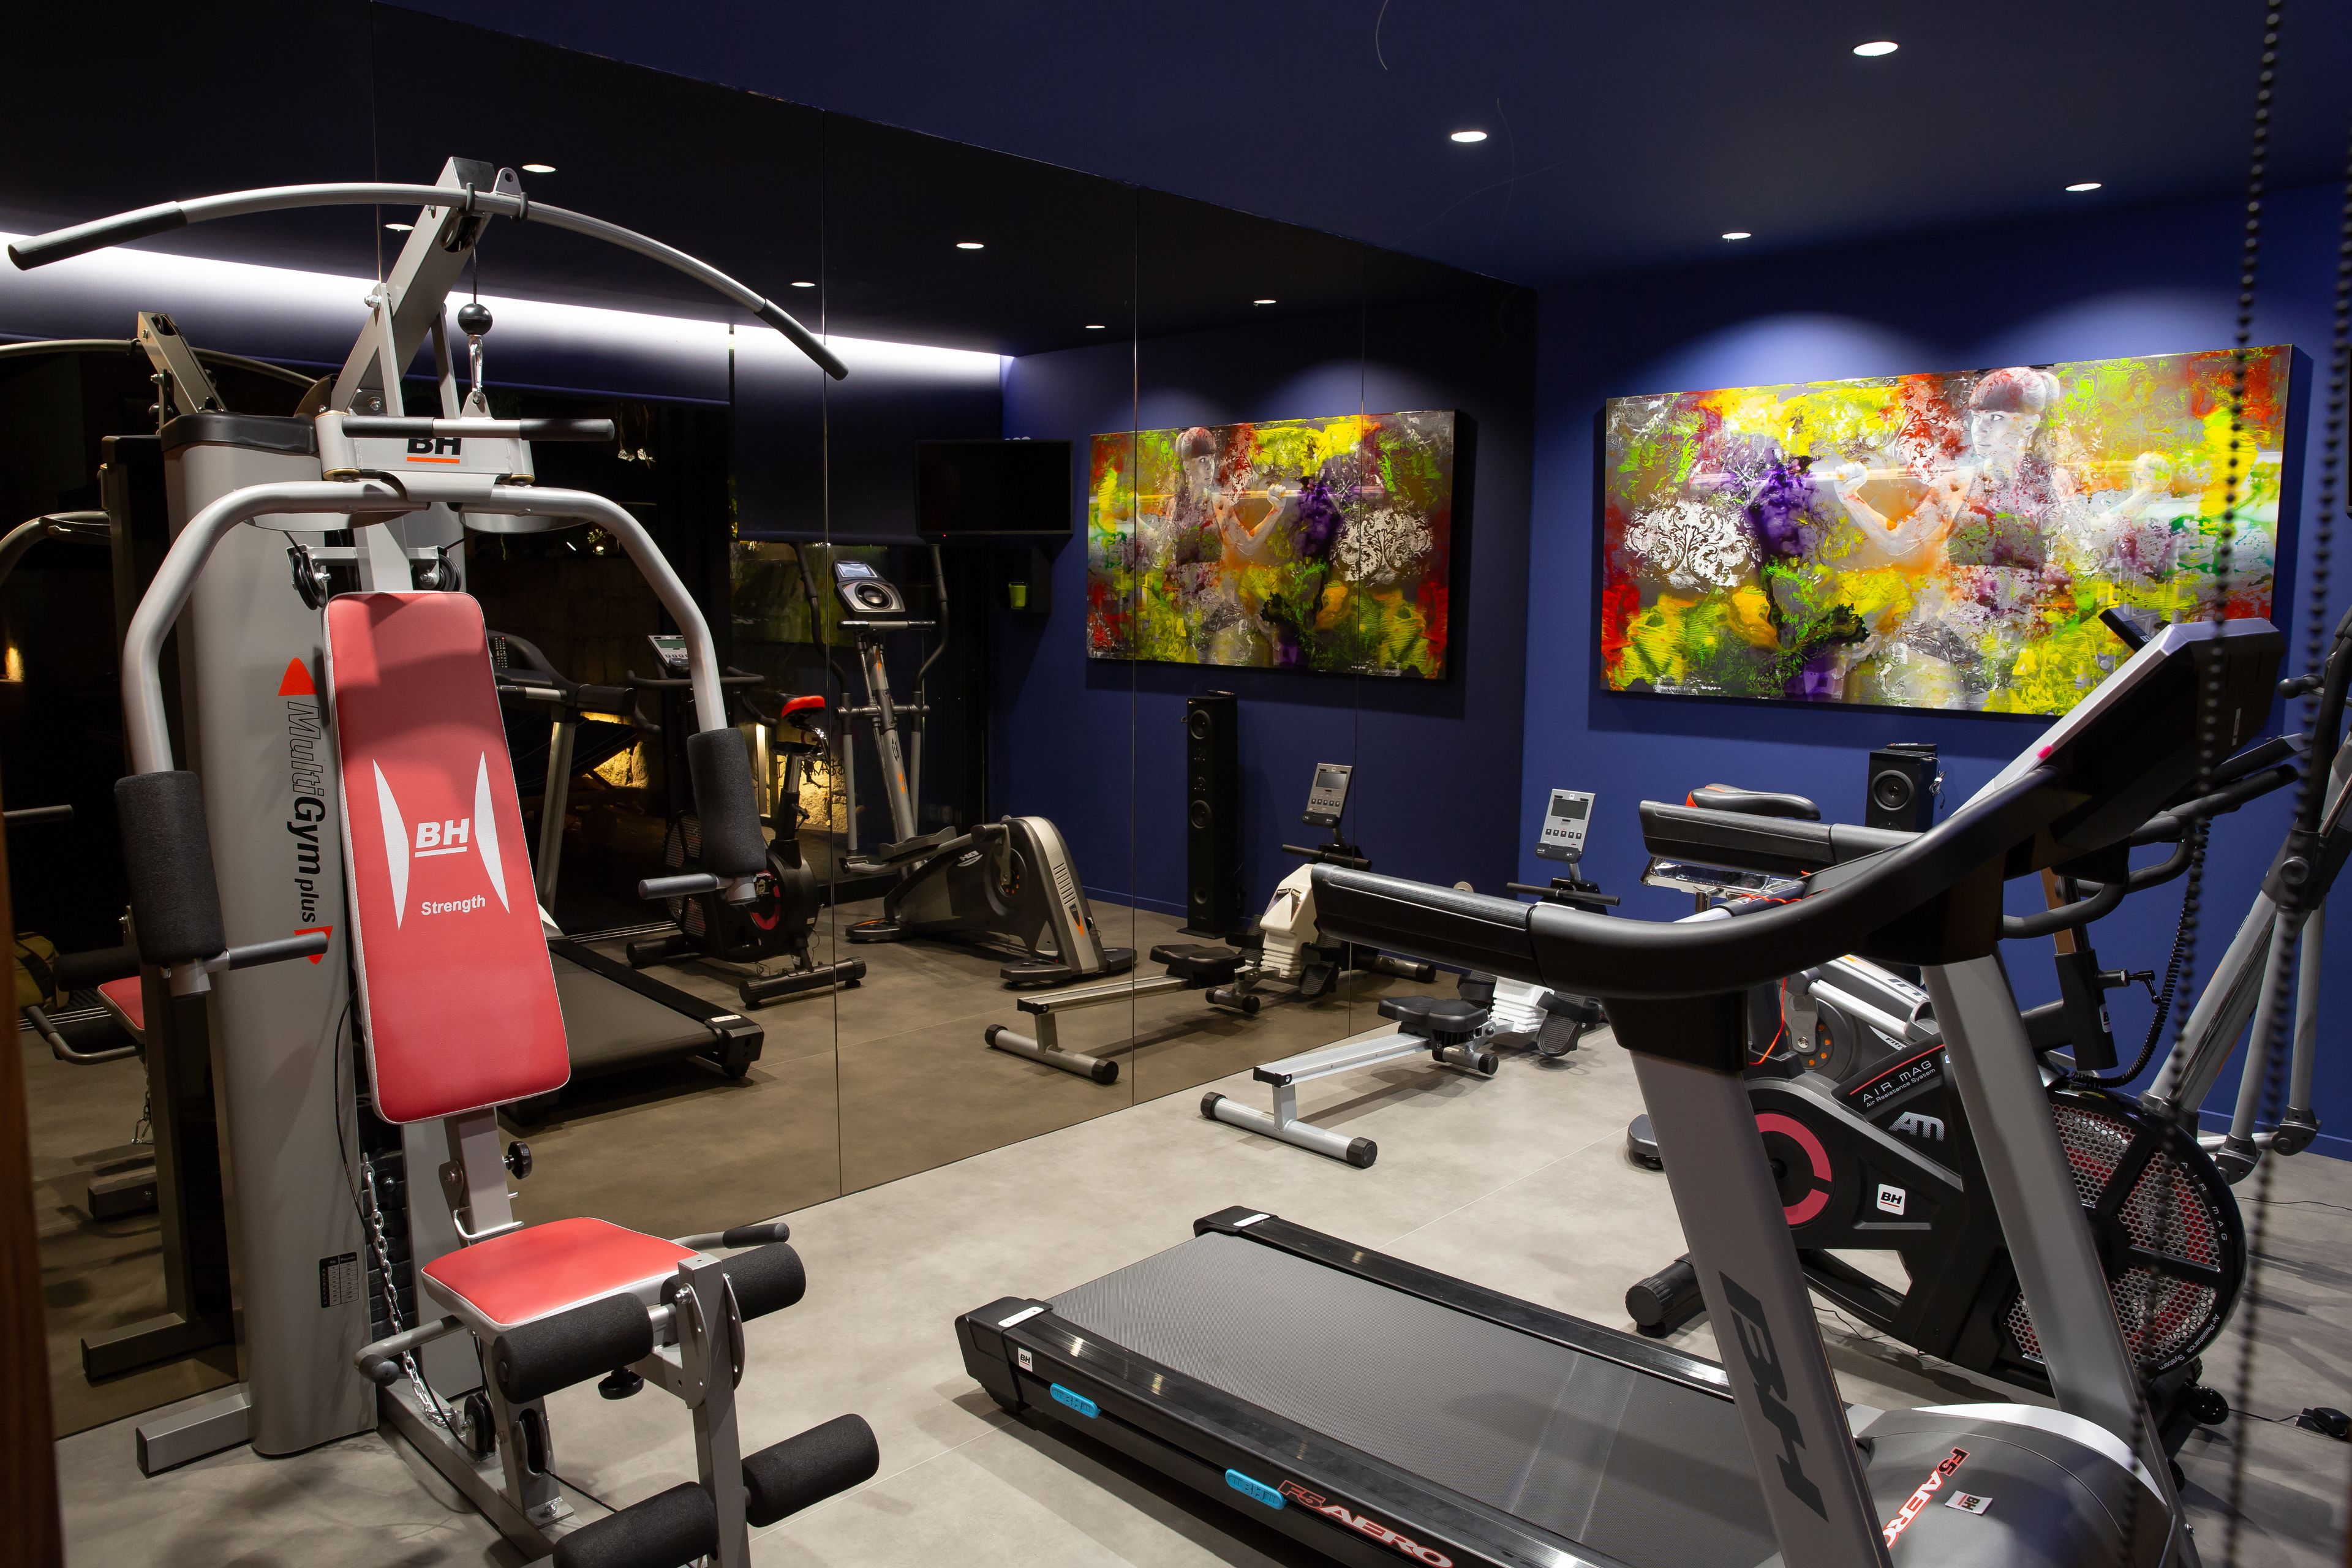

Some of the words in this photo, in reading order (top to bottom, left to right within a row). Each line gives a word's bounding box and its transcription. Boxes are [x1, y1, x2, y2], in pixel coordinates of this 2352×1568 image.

[407, 437, 461, 455] BH
[416, 818, 470, 848] BH
[295, 878, 319, 923] plus
[421, 895, 486, 915] Strength
[1863, 1082, 1892, 1102] AIR
[1899, 1060, 1932, 1082] MAG
[1876, 1082, 1910, 1101] Resistance
[1911, 1068, 1936, 1084] System
[1880, 1191, 1902, 1205] BH
[2181, 1162, 2207, 1191] AIR
[2212, 1206, 2228, 1240] MAG
[2186, 1324, 2215, 1353] Resistance
[1020, 1354, 1031, 1363] BH
[2158, 1354, 2185, 1370] System
[1719, 1271, 1829, 1523] BH
[1961, 1496, 1981, 1511] BH
